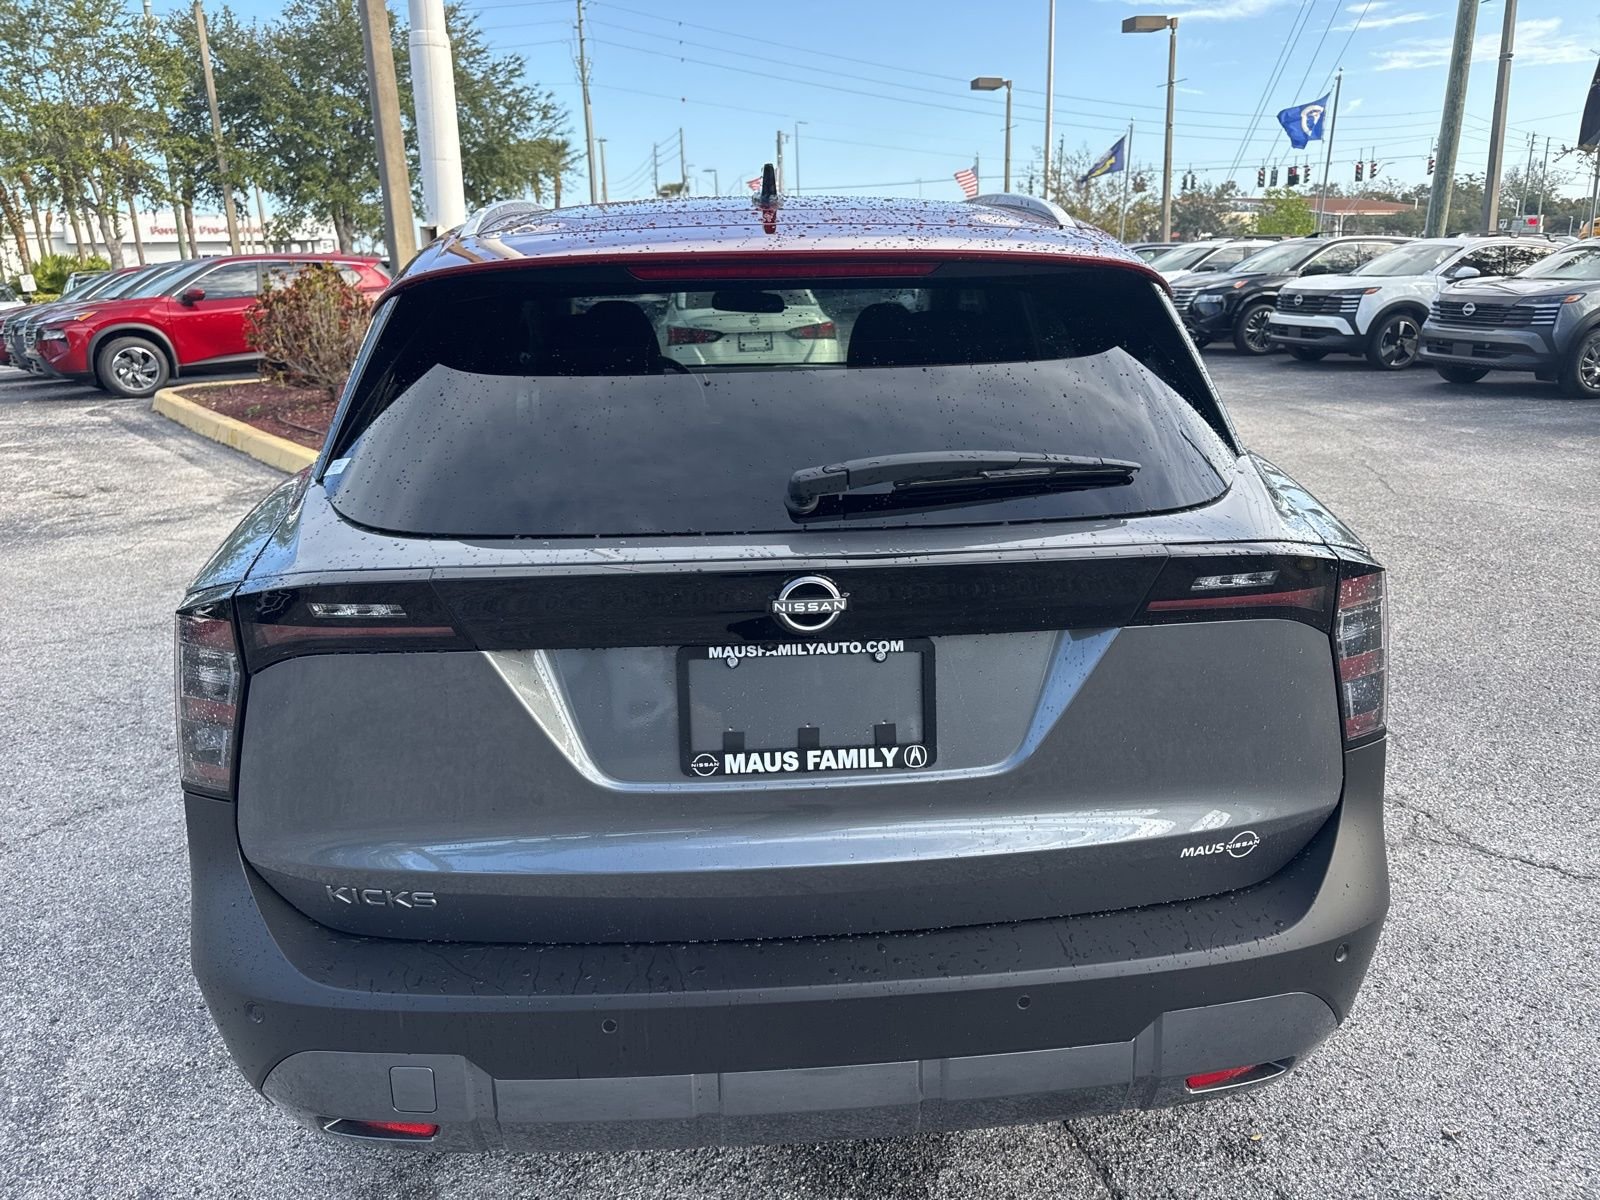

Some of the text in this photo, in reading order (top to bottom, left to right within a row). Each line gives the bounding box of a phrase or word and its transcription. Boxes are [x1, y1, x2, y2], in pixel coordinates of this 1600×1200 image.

[774, 600, 846, 612] NISSAN
[708, 640, 904, 659] MAUSFAMILYAUTO.COM
[724, 750, 799, 774] MAUS
[806, 747, 899, 771] FAMILY
[1180, 838, 1260, 858] MAUS NISSAN
[325, 885, 437, 909] KICKS
